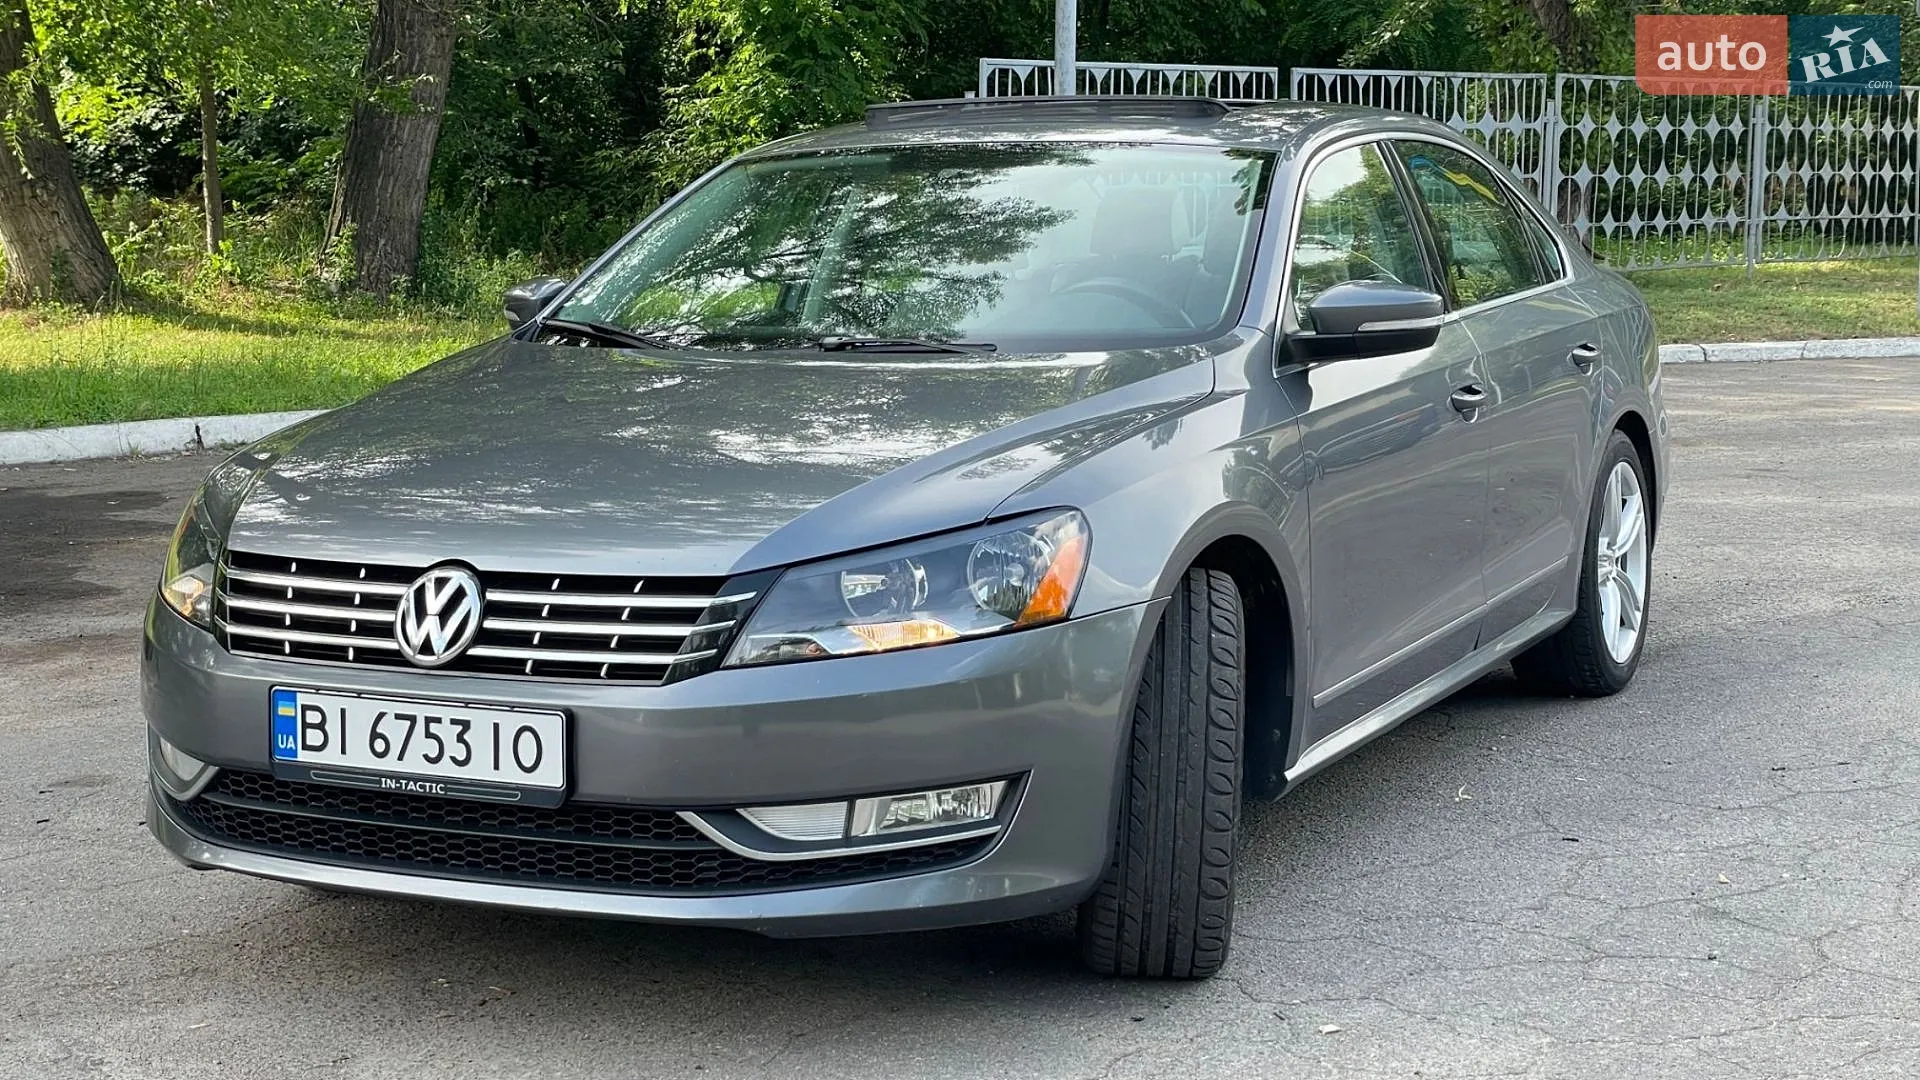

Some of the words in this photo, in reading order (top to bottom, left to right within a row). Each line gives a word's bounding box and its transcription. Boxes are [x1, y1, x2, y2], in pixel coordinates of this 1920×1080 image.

[278, 734, 296, 751] UA
[300, 703, 347, 755] BI
[368, 711, 472, 767] 6753
[492, 722, 543, 774] IO
[380, 777, 445, 794] IN-TACTIC
